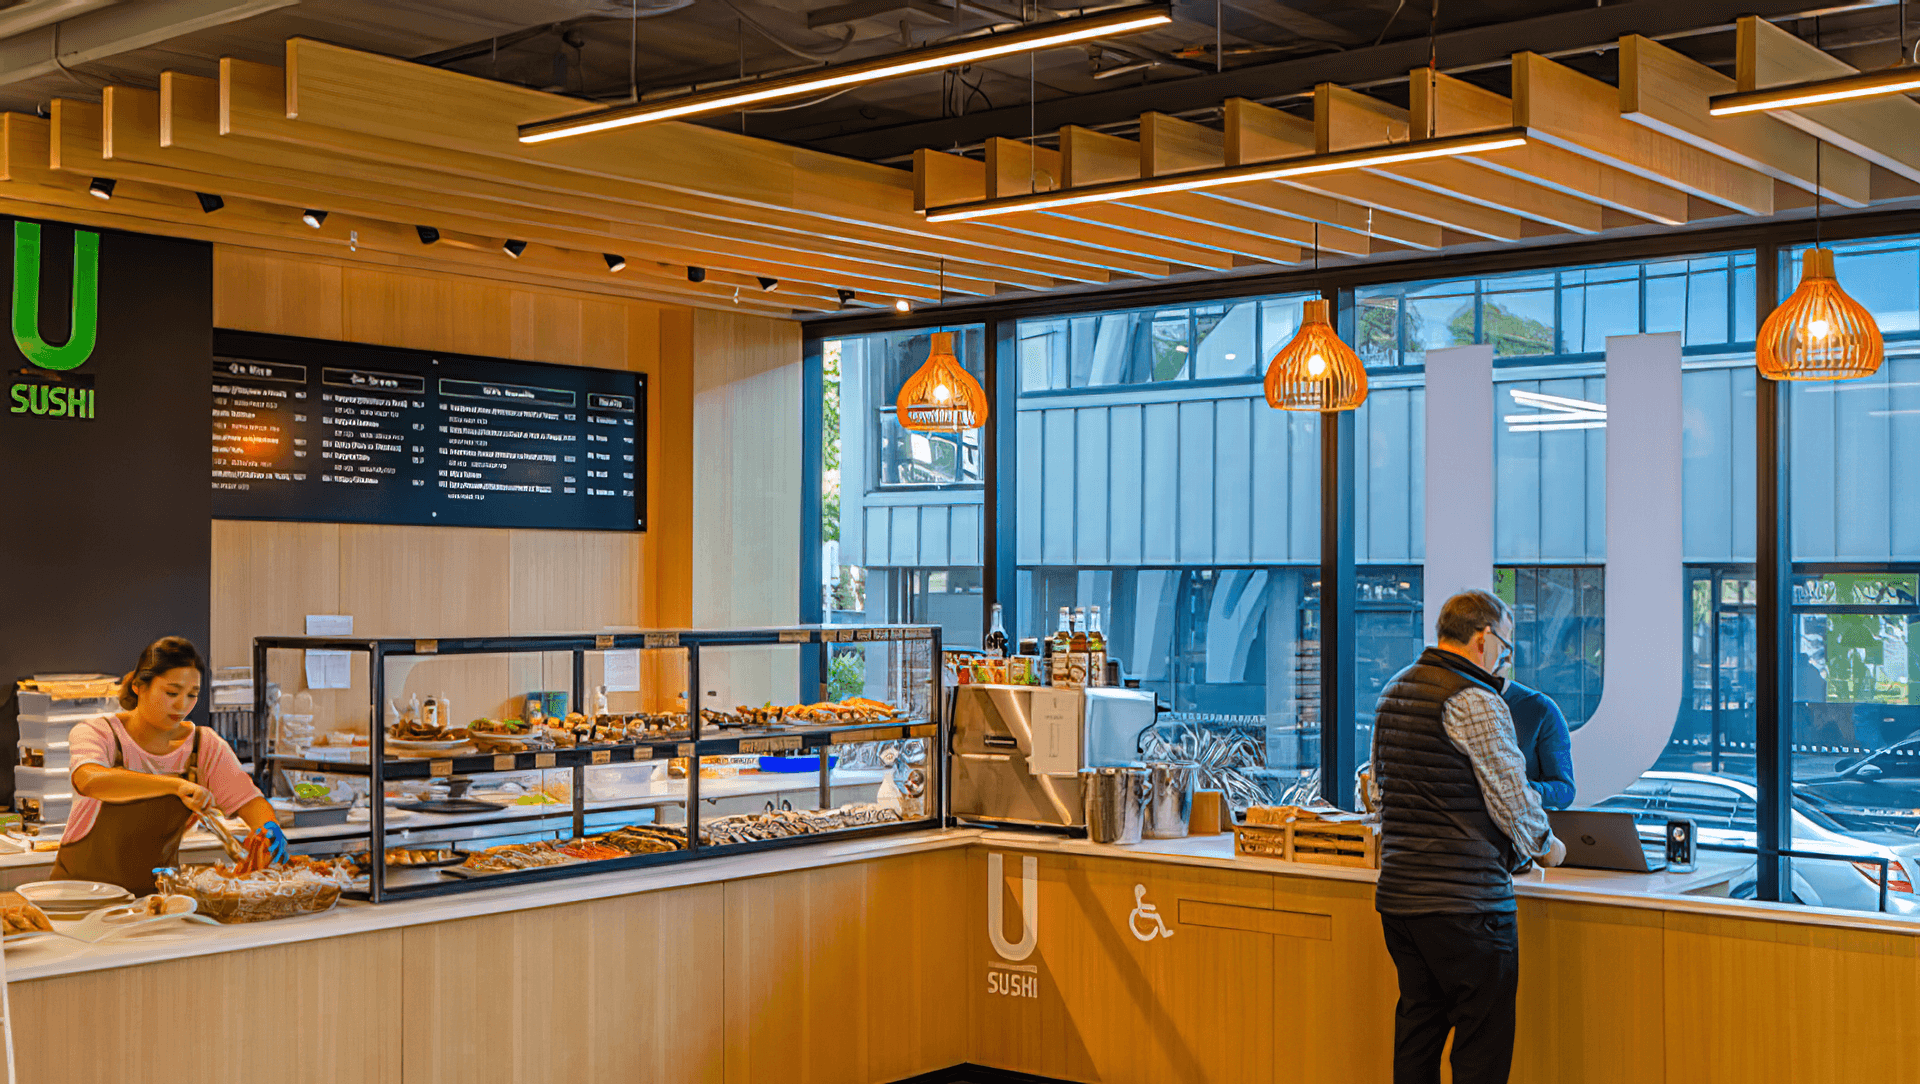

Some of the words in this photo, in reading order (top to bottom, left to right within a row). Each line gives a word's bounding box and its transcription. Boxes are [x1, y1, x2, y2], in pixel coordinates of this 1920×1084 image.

[12, 220, 100, 371] U
[10, 383, 95, 419] SUSHI
[988, 852, 1038, 962] U
[987, 971, 1038, 999] SUSHI
